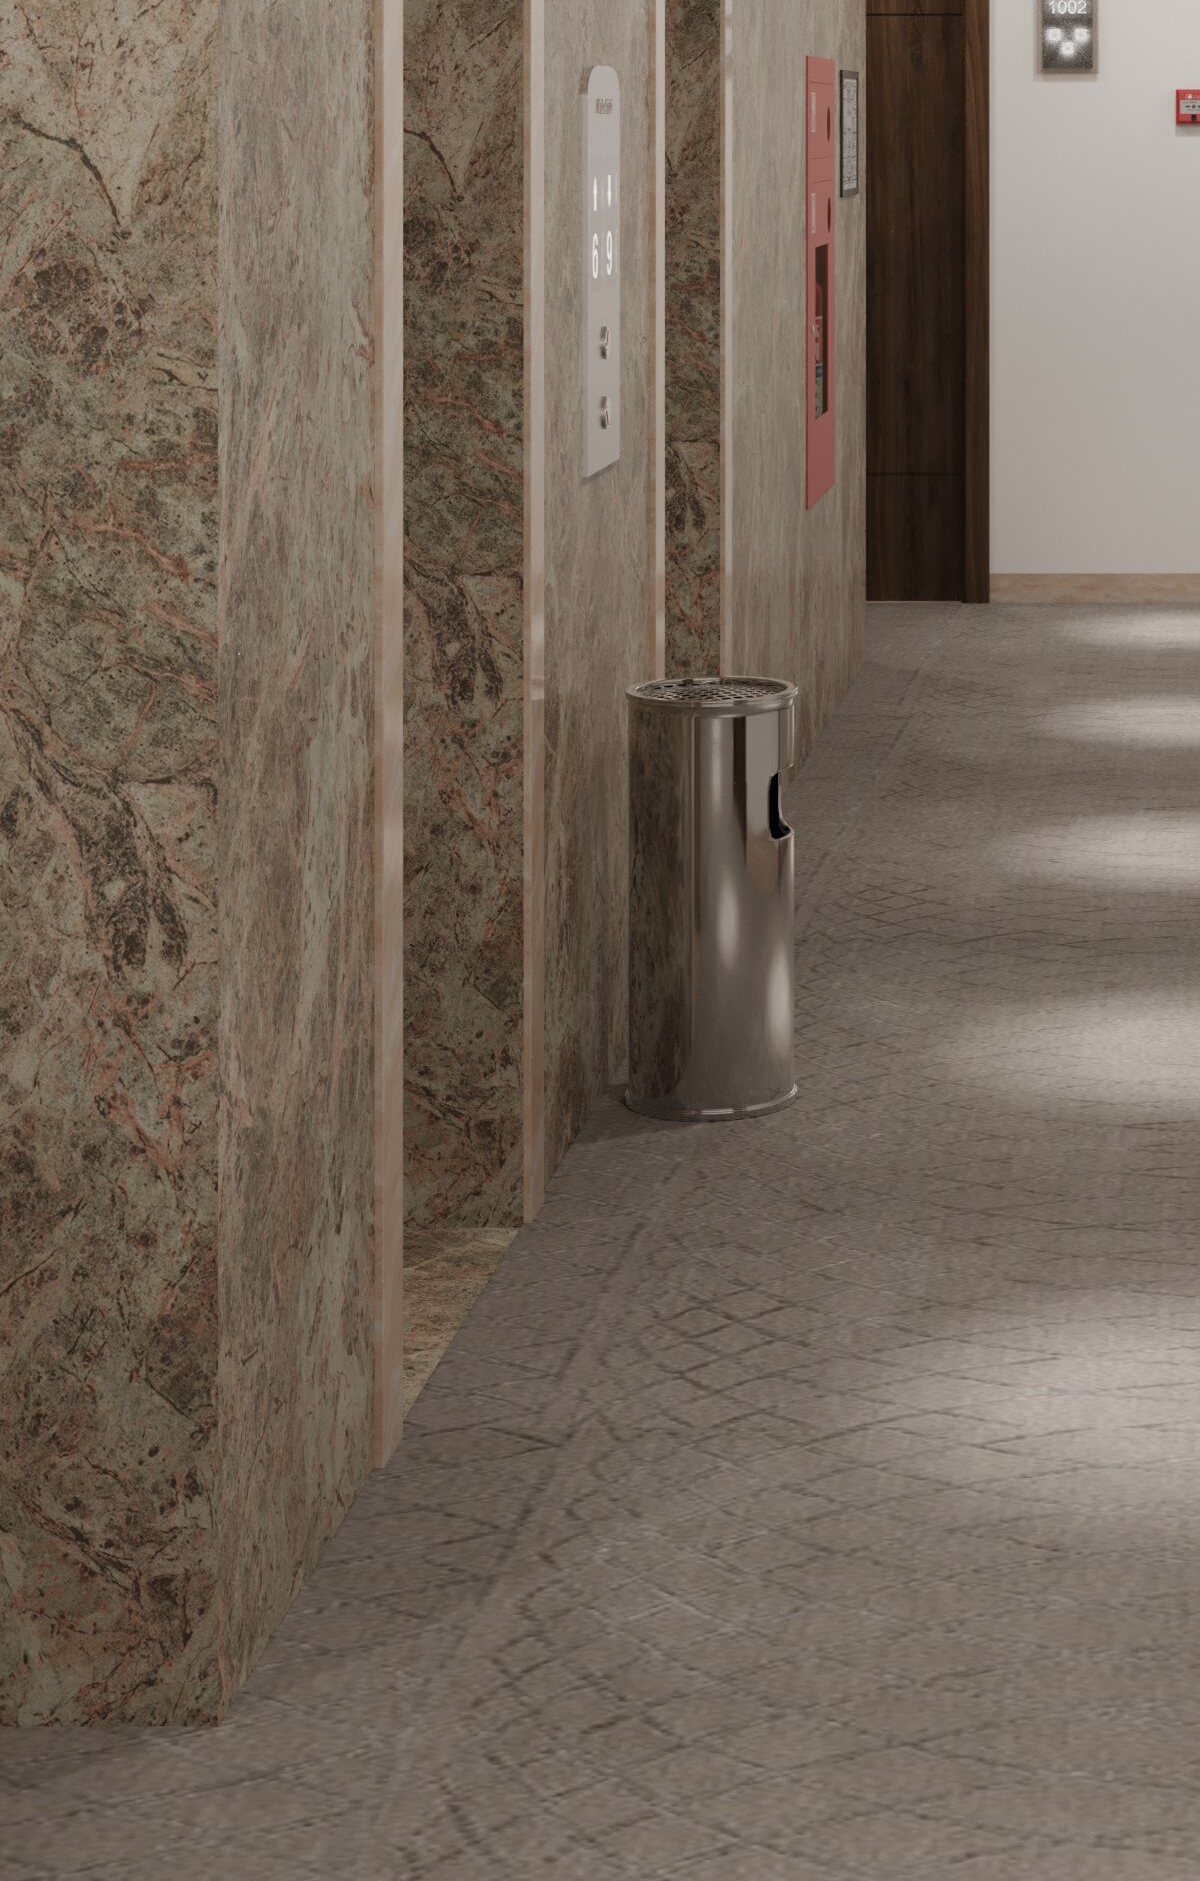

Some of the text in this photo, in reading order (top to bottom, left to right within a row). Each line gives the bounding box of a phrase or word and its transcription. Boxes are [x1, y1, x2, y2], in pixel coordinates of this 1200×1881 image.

[1049, 0, 1087, 15] 1002
[592, 230, 613, 280] 6 9
